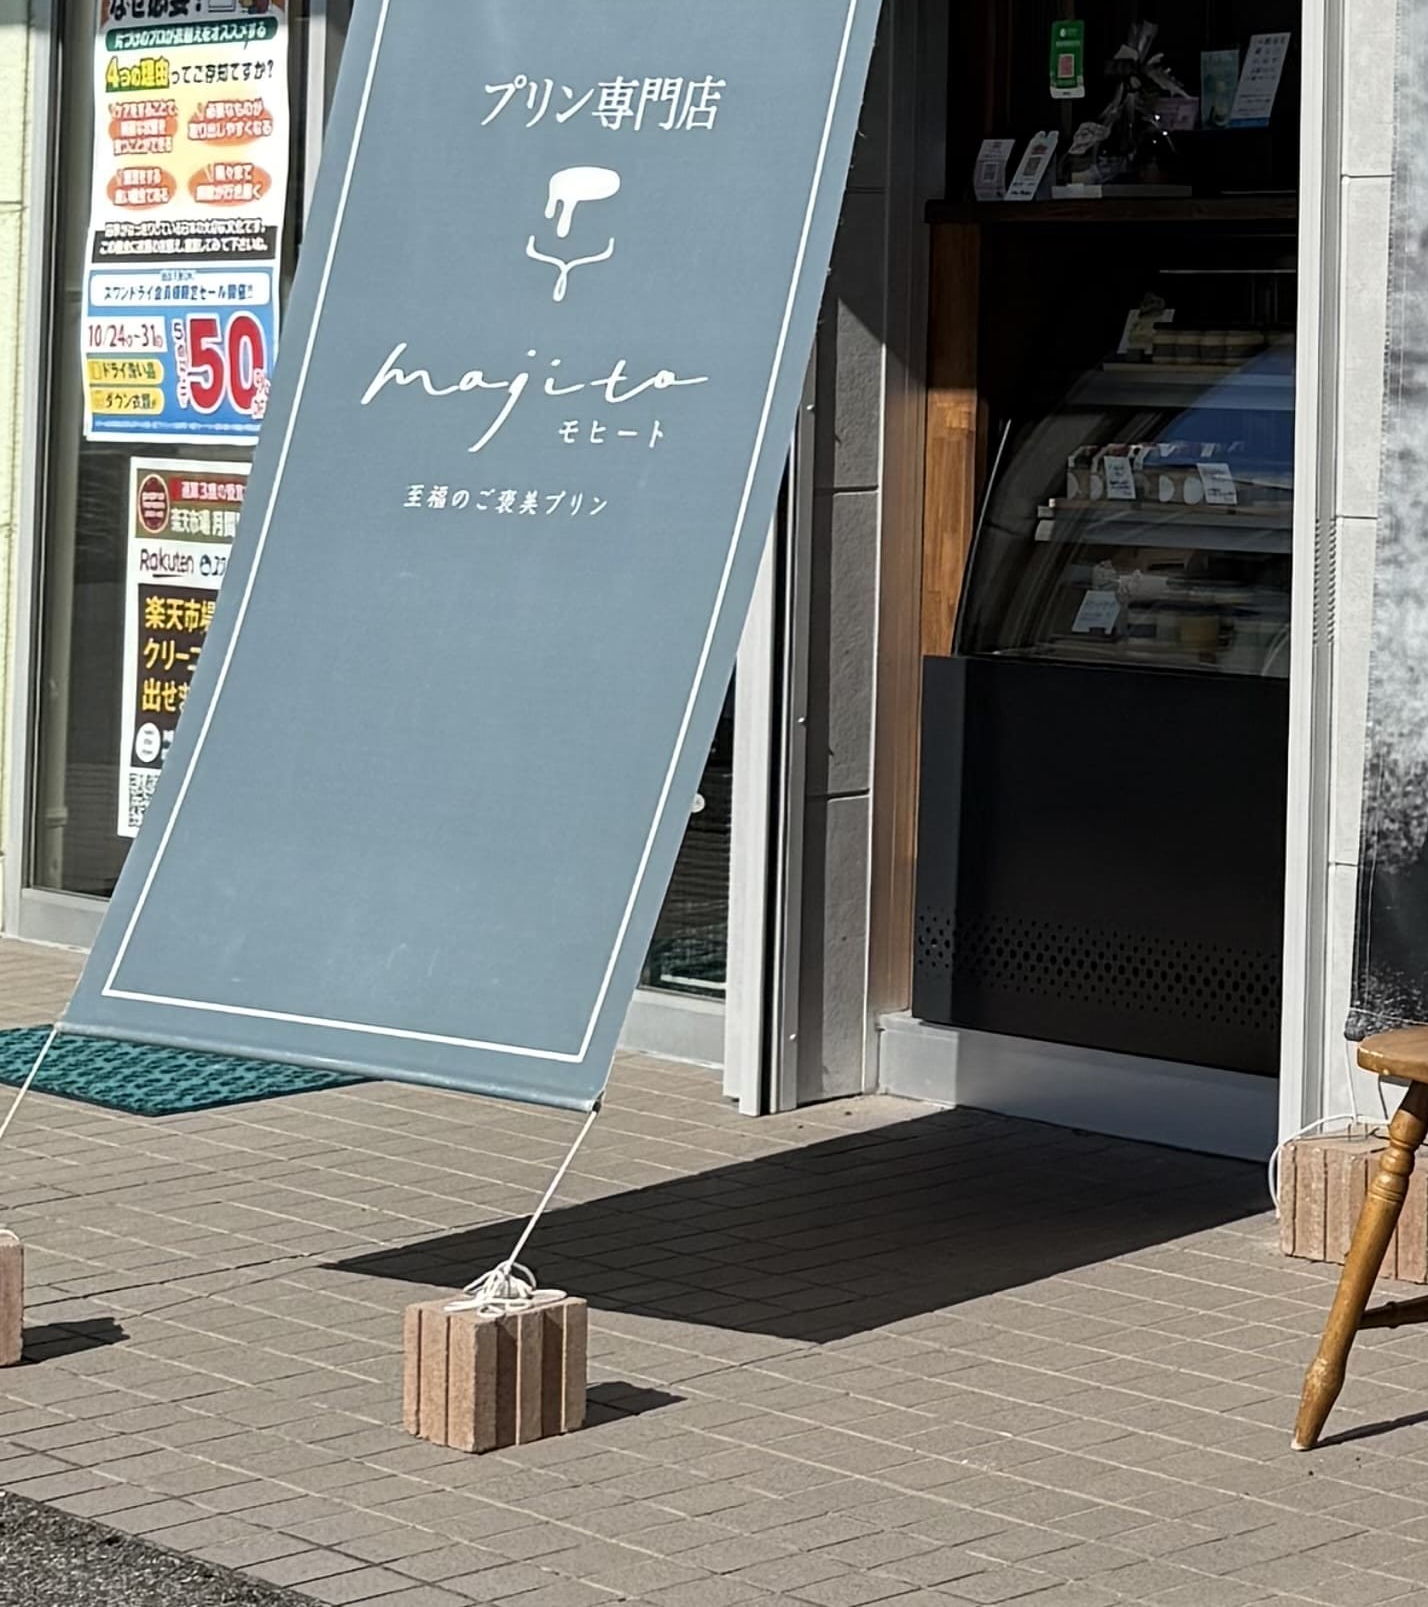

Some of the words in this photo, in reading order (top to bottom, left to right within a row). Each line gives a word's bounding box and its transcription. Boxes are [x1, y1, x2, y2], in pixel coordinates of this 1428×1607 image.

[481, 74, 726, 132] プリン専門店
[558, 420, 665, 449] モヒート
[403, 483, 608, 517] 至福のご褒美プリン
[140, 547, 195, 575] Rakuten
